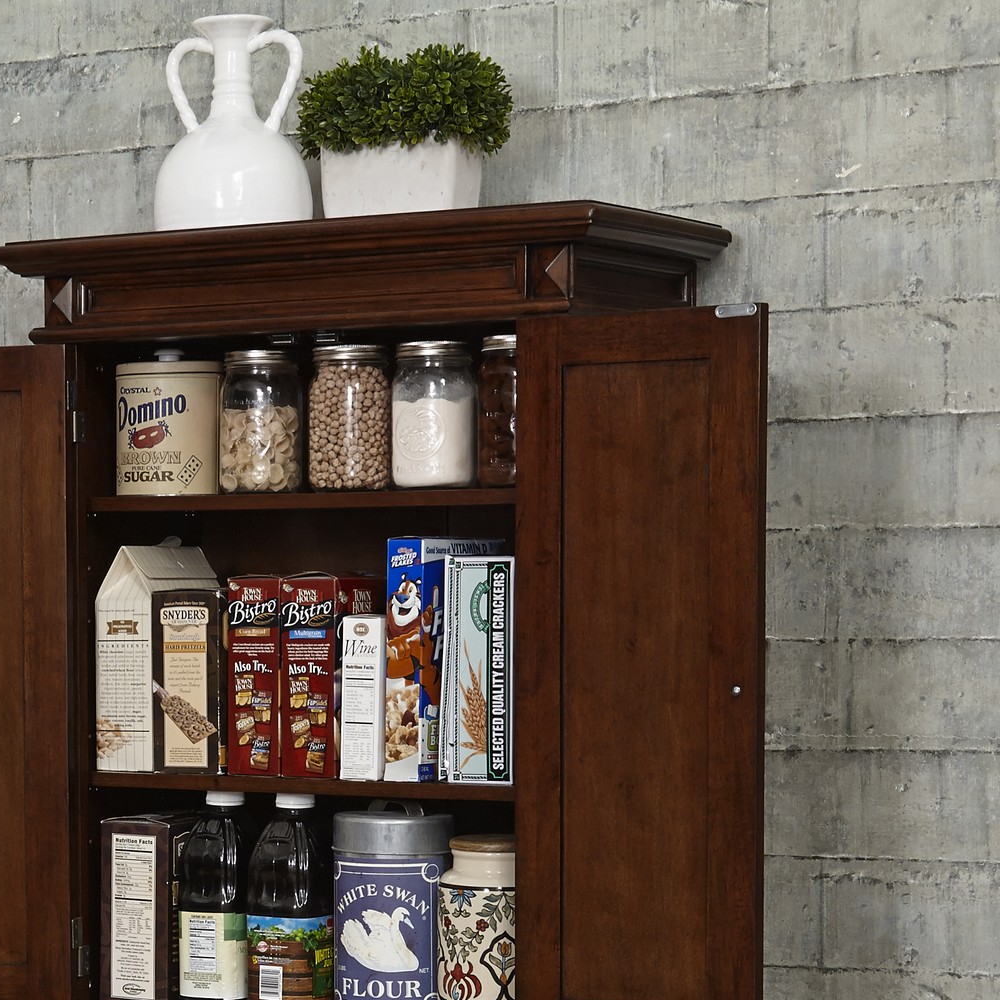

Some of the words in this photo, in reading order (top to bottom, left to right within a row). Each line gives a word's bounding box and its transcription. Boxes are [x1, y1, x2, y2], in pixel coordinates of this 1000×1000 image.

[118, 394, 187, 432] Domino
[120, 451, 182, 465] BROWN
[124, 471, 175, 482] SUGAR
[450, 543, 480, 554] VITAMIN
[480, 544, 488, 554] D
[391, 552, 417, 562] FROSTED
[392, 559, 414, 568] FLAKES
[242, 594, 262, 602] HOUSE
[243, 588, 262, 596] TOWN
[298, 588, 316, 597] TOWN
[353, 589, 371, 602] TOWN
[296, 595, 318, 604] HOUSE
[492, 572, 506, 630] CRACKERS
[228, 599, 276, 625] Bistro
[282, 600, 332, 627] Bistro
[352, 602, 372, 614] HOUSE
[162, 609, 206, 620] SNYDER'S
[344, 640, 378, 656] Wine
[492, 631, 505, 669] CREAM
[234, 661, 252, 673] Also
[288, 664, 306, 676] Also
[492, 671, 506, 716] QUALITY
[492, 718, 505, 770] SELECTED
[338, 884, 378, 914] WHITE
[383, 884, 430, 915] SWAN
[342, 977, 422, 998] FLOUR
